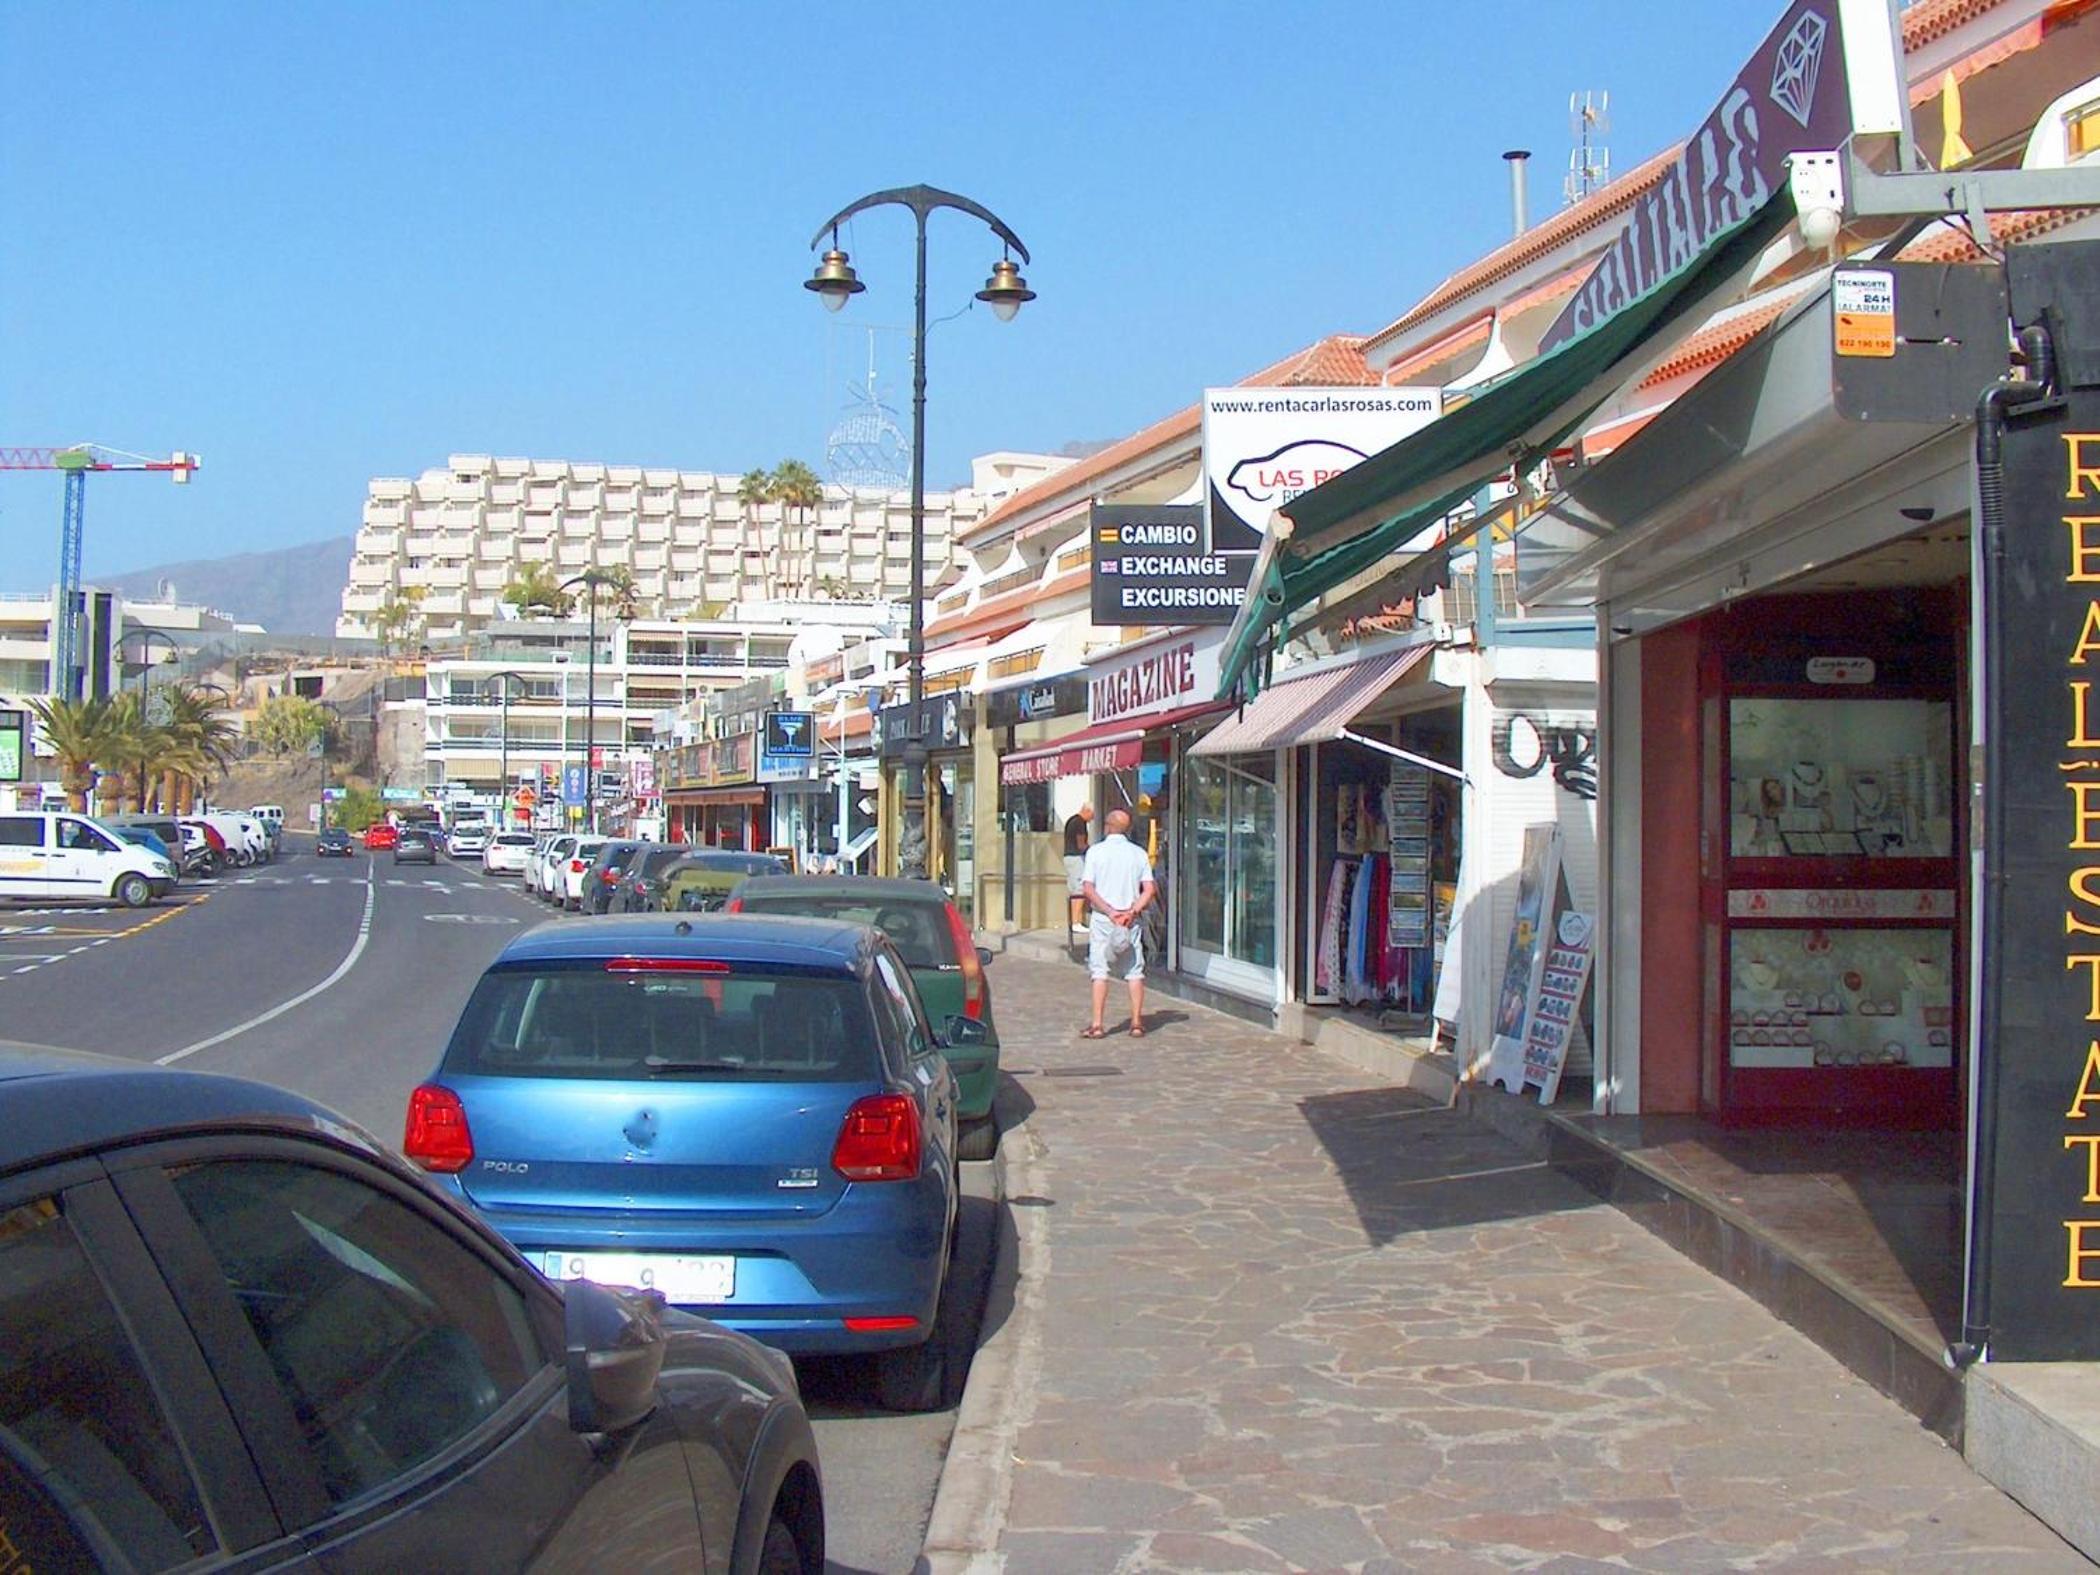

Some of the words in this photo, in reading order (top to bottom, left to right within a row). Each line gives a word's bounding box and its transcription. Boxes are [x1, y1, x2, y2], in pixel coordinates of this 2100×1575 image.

[1211, 397, 1432, 413] www.rentacarlasrosas.com
[1258, 469, 1304, 487] LAS
[1120, 524, 1197, 545] CAMBIO
[1121, 556, 1227, 576] EXCHANGE
[1092, 642, 1195, 722] MAGAZINE
[1036, 755, 1060, 778] STORE
[1080, 745, 1119, 772] MARKET
[483, 1160, 529, 1174] POLO
[788, 1167, 819, 1179] TSI
